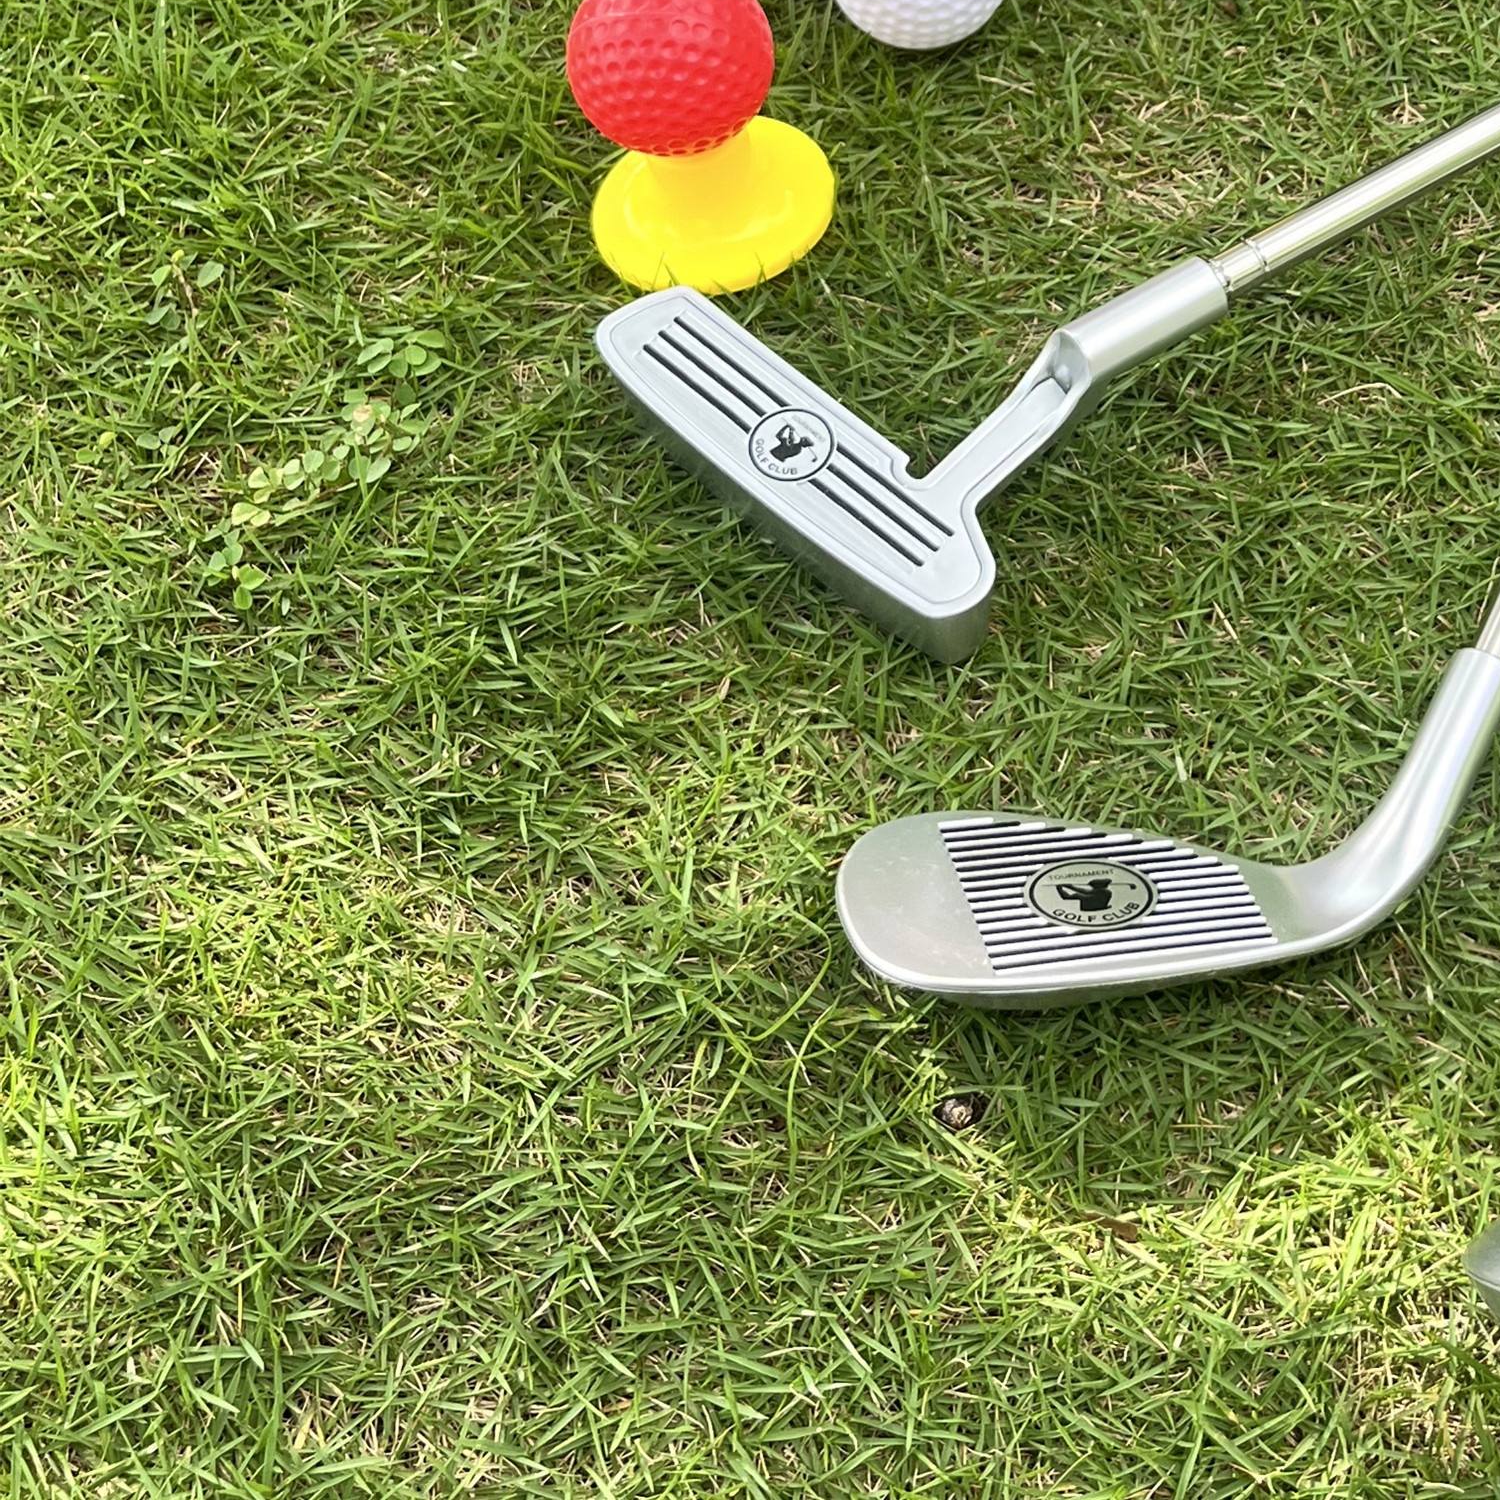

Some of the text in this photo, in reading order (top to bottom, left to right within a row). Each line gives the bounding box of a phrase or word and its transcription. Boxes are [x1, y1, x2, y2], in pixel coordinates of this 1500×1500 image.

[754, 438, 799, 476] GOLF CLUB
[1052, 902, 1140, 923] GOLF CLUB
